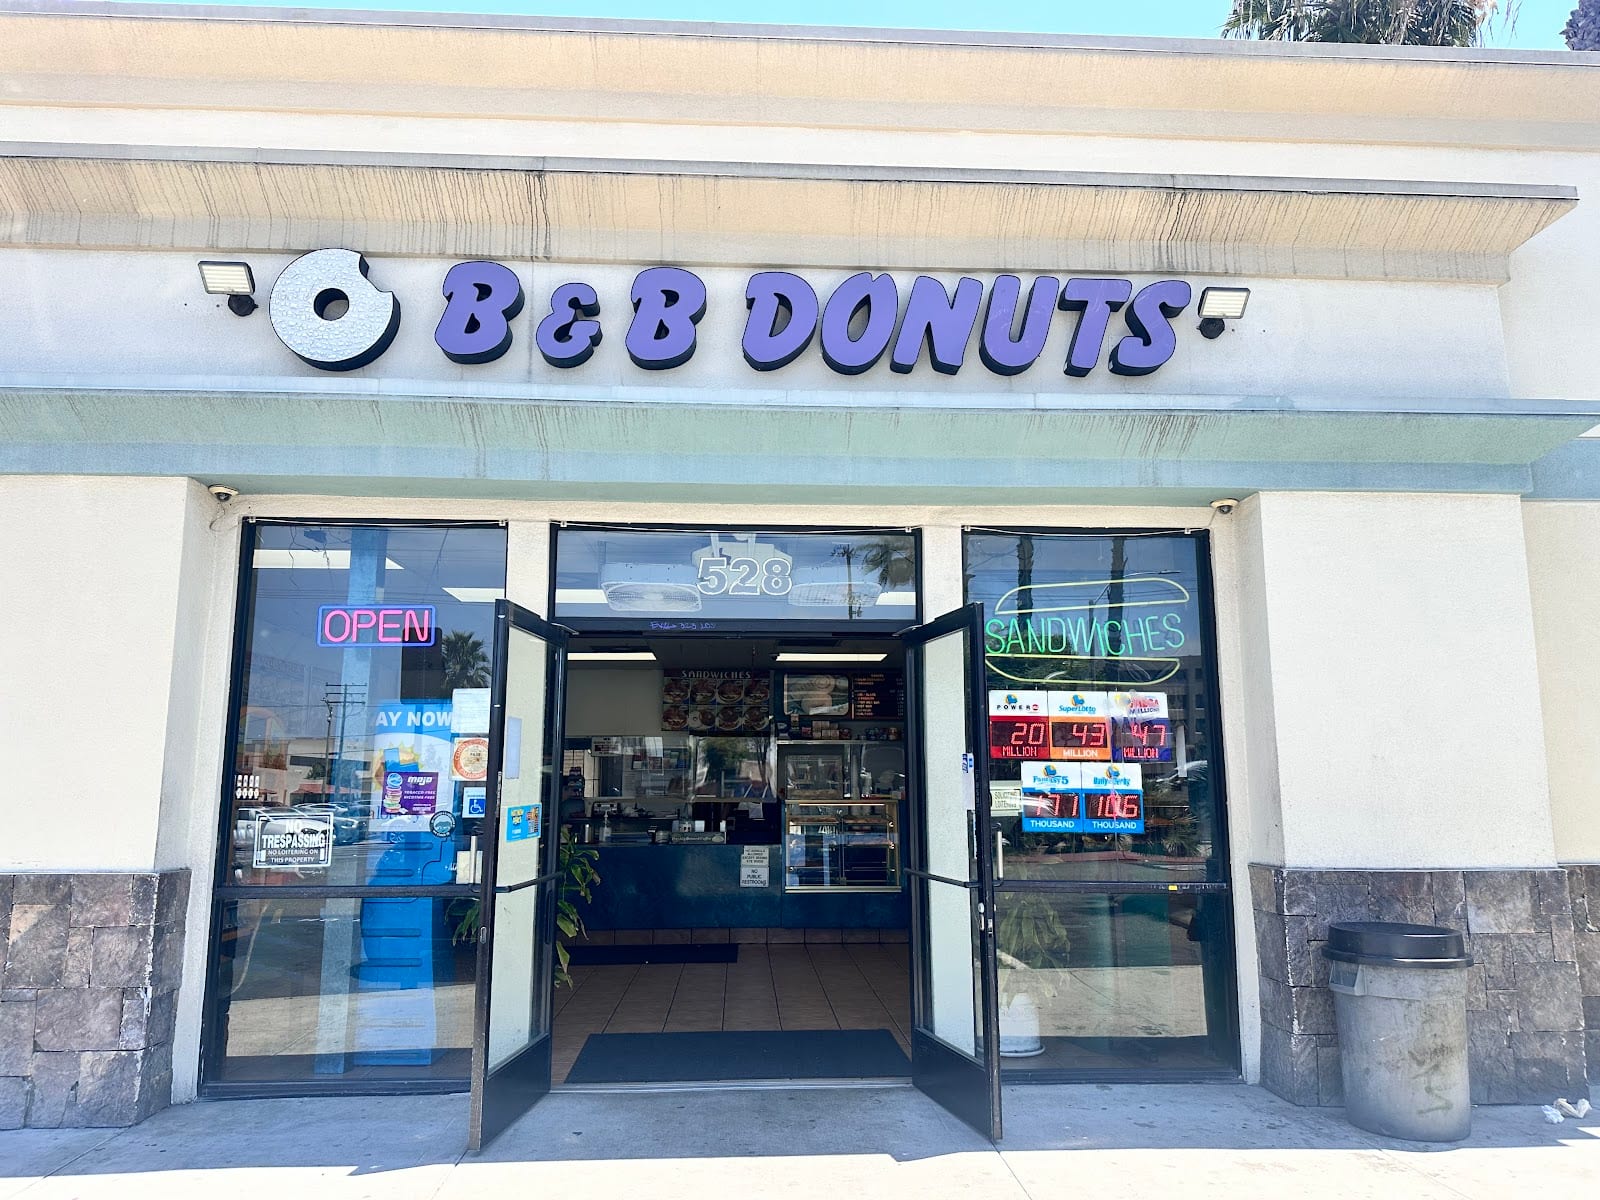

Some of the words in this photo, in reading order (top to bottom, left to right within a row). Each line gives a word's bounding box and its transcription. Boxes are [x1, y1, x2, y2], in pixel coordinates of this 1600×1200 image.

[435, 261, 523, 362] B
[536, 283, 601, 366] &
[626, 267, 706, 370] B
[741, 271, 1191, 376] DONUTS
[697, 557, 792, 595] 528
[324, 609, 430, 642] OPEN
[985, 613, 1185, 657] SANDWICHES
[682, 671, 751, 679] SANDWICHES
[406, 711, 453, 727] NOW
[1011, 723, 1045, 745] 20
[1072, 724, 1106, 746] 43
[1131, 724, 1167, 746] 47
[1002, 746, 1037, 757] MILLION
[1063, 749, 1097, 757] MILLION
[1123, 747, 1159, 758] MILLION
[407, 776, 433, 785] mojo
[1061, 775, 1069, 785] 5
[1097, 795, 1138, 818] 106
[285, 819, 302, 834] NO
[1030, 820, 1075, 828] THOUSAND
[1092, 820, 1137, 829] THOUSAND
[261, 833, 326, 849] TRESPASSING
